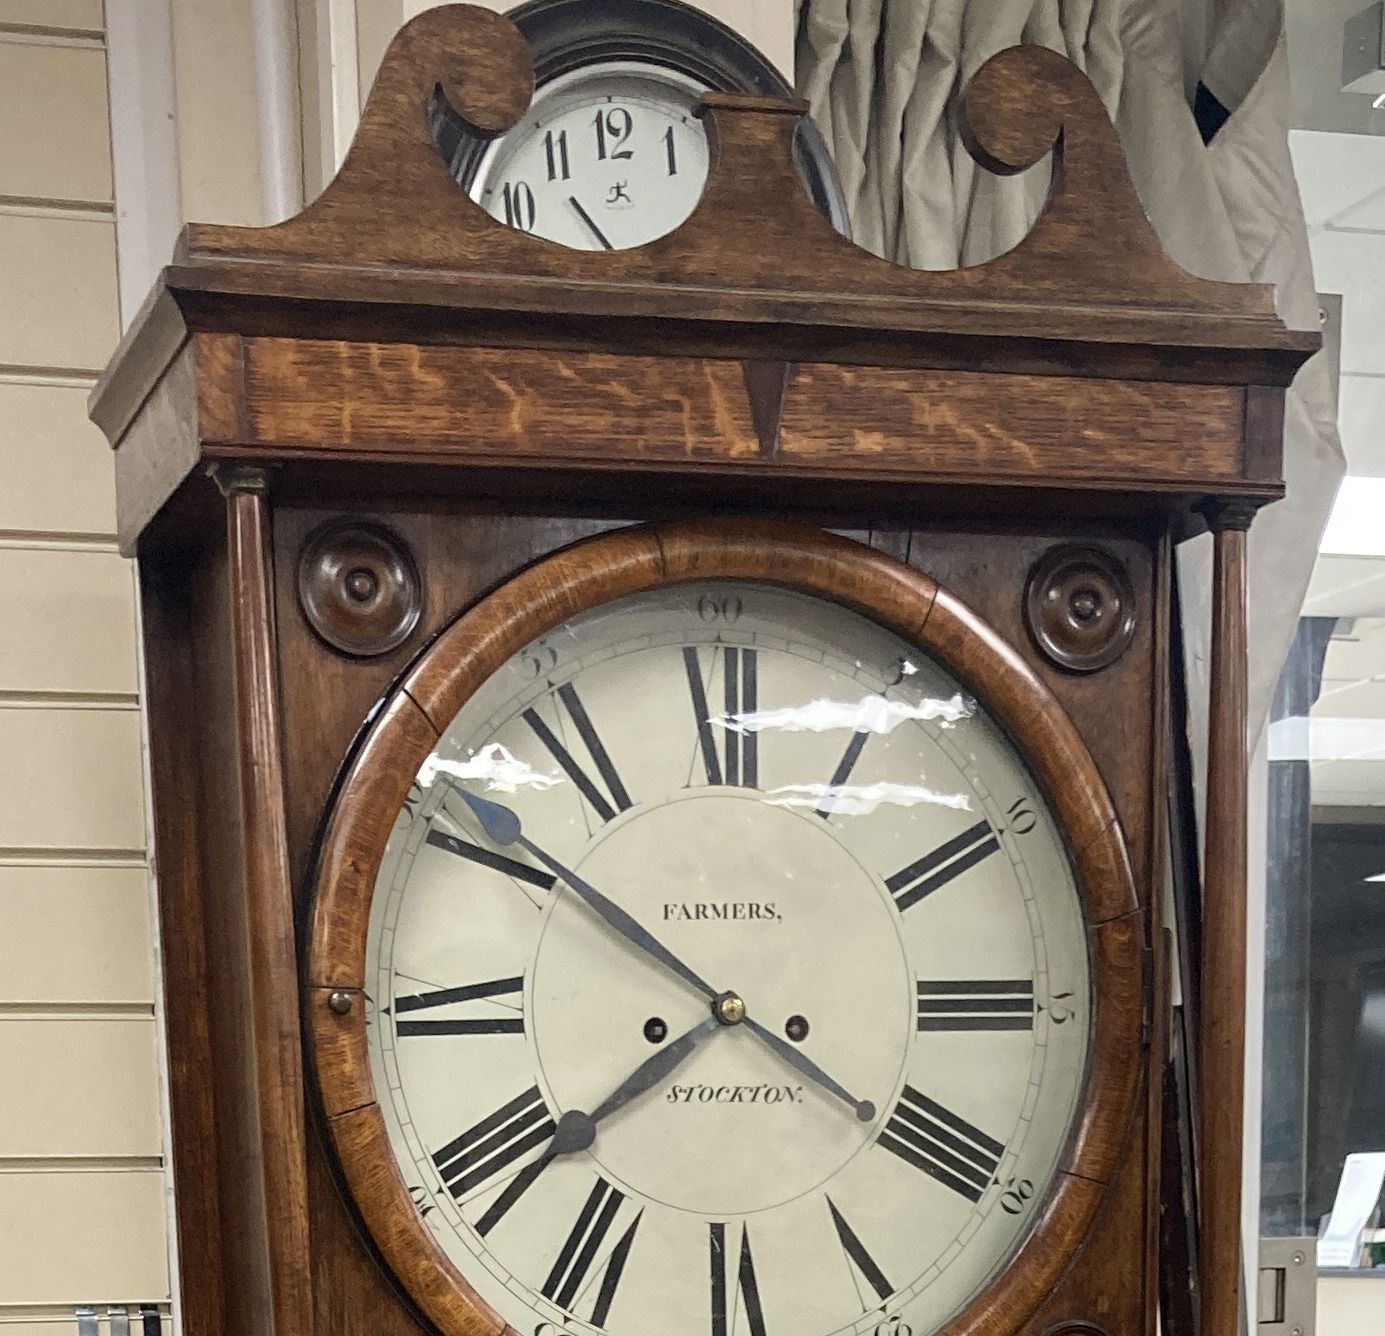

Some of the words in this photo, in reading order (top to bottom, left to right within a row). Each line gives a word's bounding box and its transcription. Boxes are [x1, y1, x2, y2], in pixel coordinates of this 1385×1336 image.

[541, 129, 572, 182] 11
[590, 107, 635, 161] 12
[660, 126, 678, 177] 1
[502, 180, 536, 232] 10
[698, 596, 743, 623] 60
[681, 646, 759, 789] XII
[1005, 797, 1037, 835] 10
[662, 902, 783, 924] FARMERS,
[1048, 992, 1076, 1025] 15
[1000, 1174, 1035, 1215] 20
